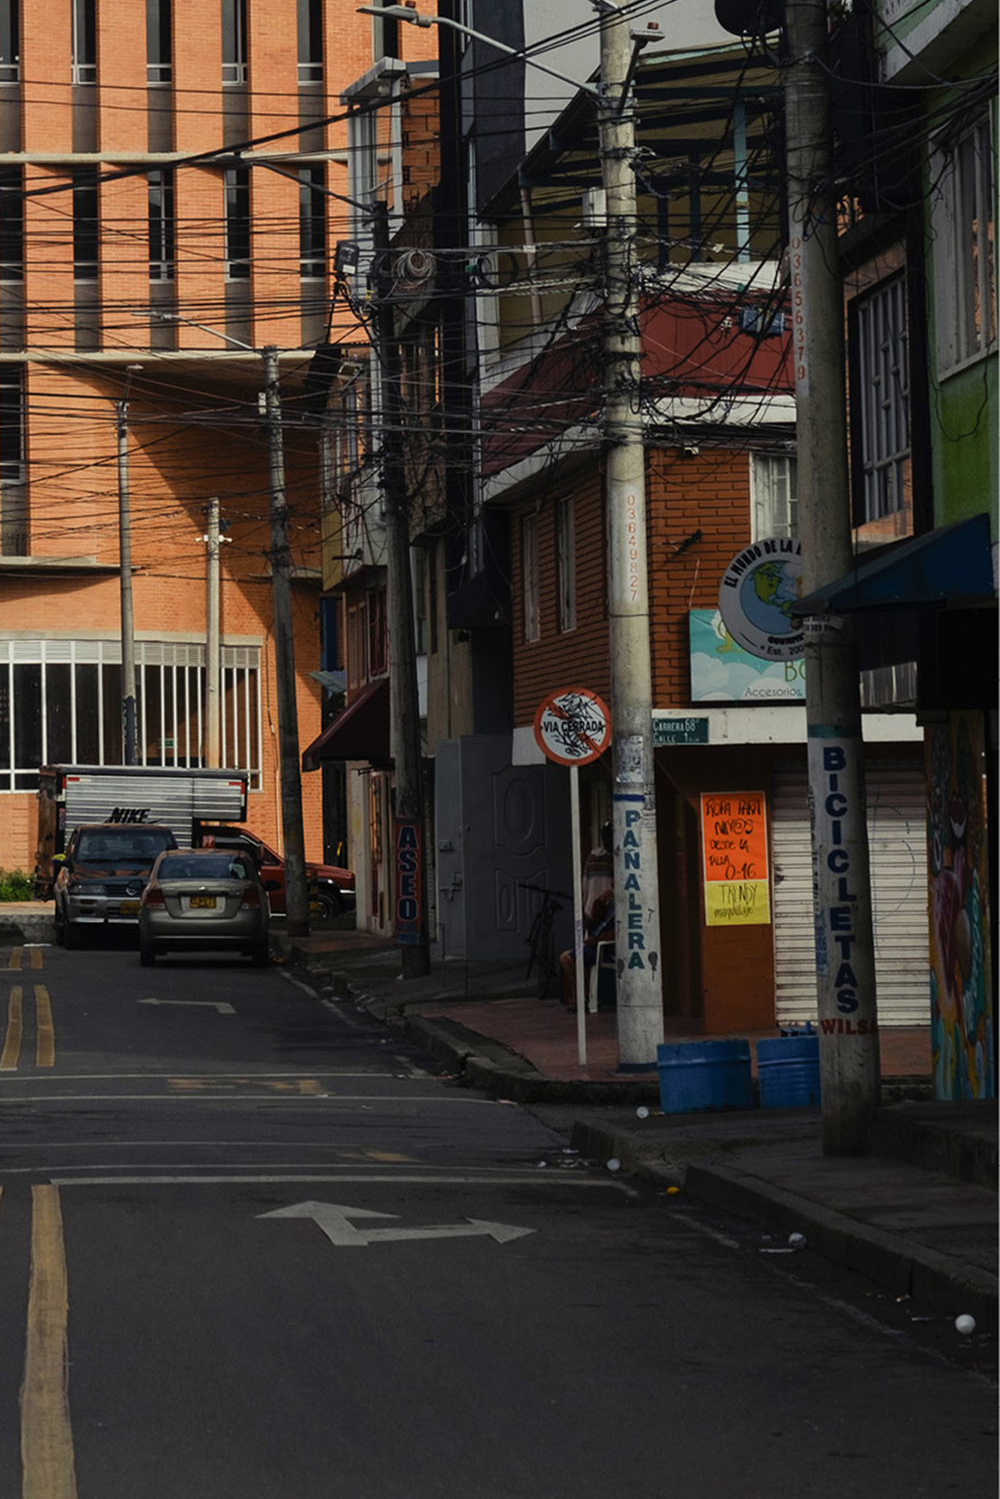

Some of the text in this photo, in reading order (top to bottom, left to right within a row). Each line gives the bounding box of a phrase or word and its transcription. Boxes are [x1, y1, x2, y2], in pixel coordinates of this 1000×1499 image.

[627, 494, 638, 601] 03649827
[763, 540, 777, 554] DE
[780, 539, 793, 553] LA
[730, 545, 762, 576] MUNDO
[724, 576, 739, 588] EL
[543, 720, 603, 732] VIA CERRADA
[105, 807, 150, 824] NIKE
[706, 799, 731, 817] ROPA
[397, 825, 420, 922] ASEO
[823, 746, 858, 1014] BICICLETAS
[624, 810, 646, 970] PAÑALERA
